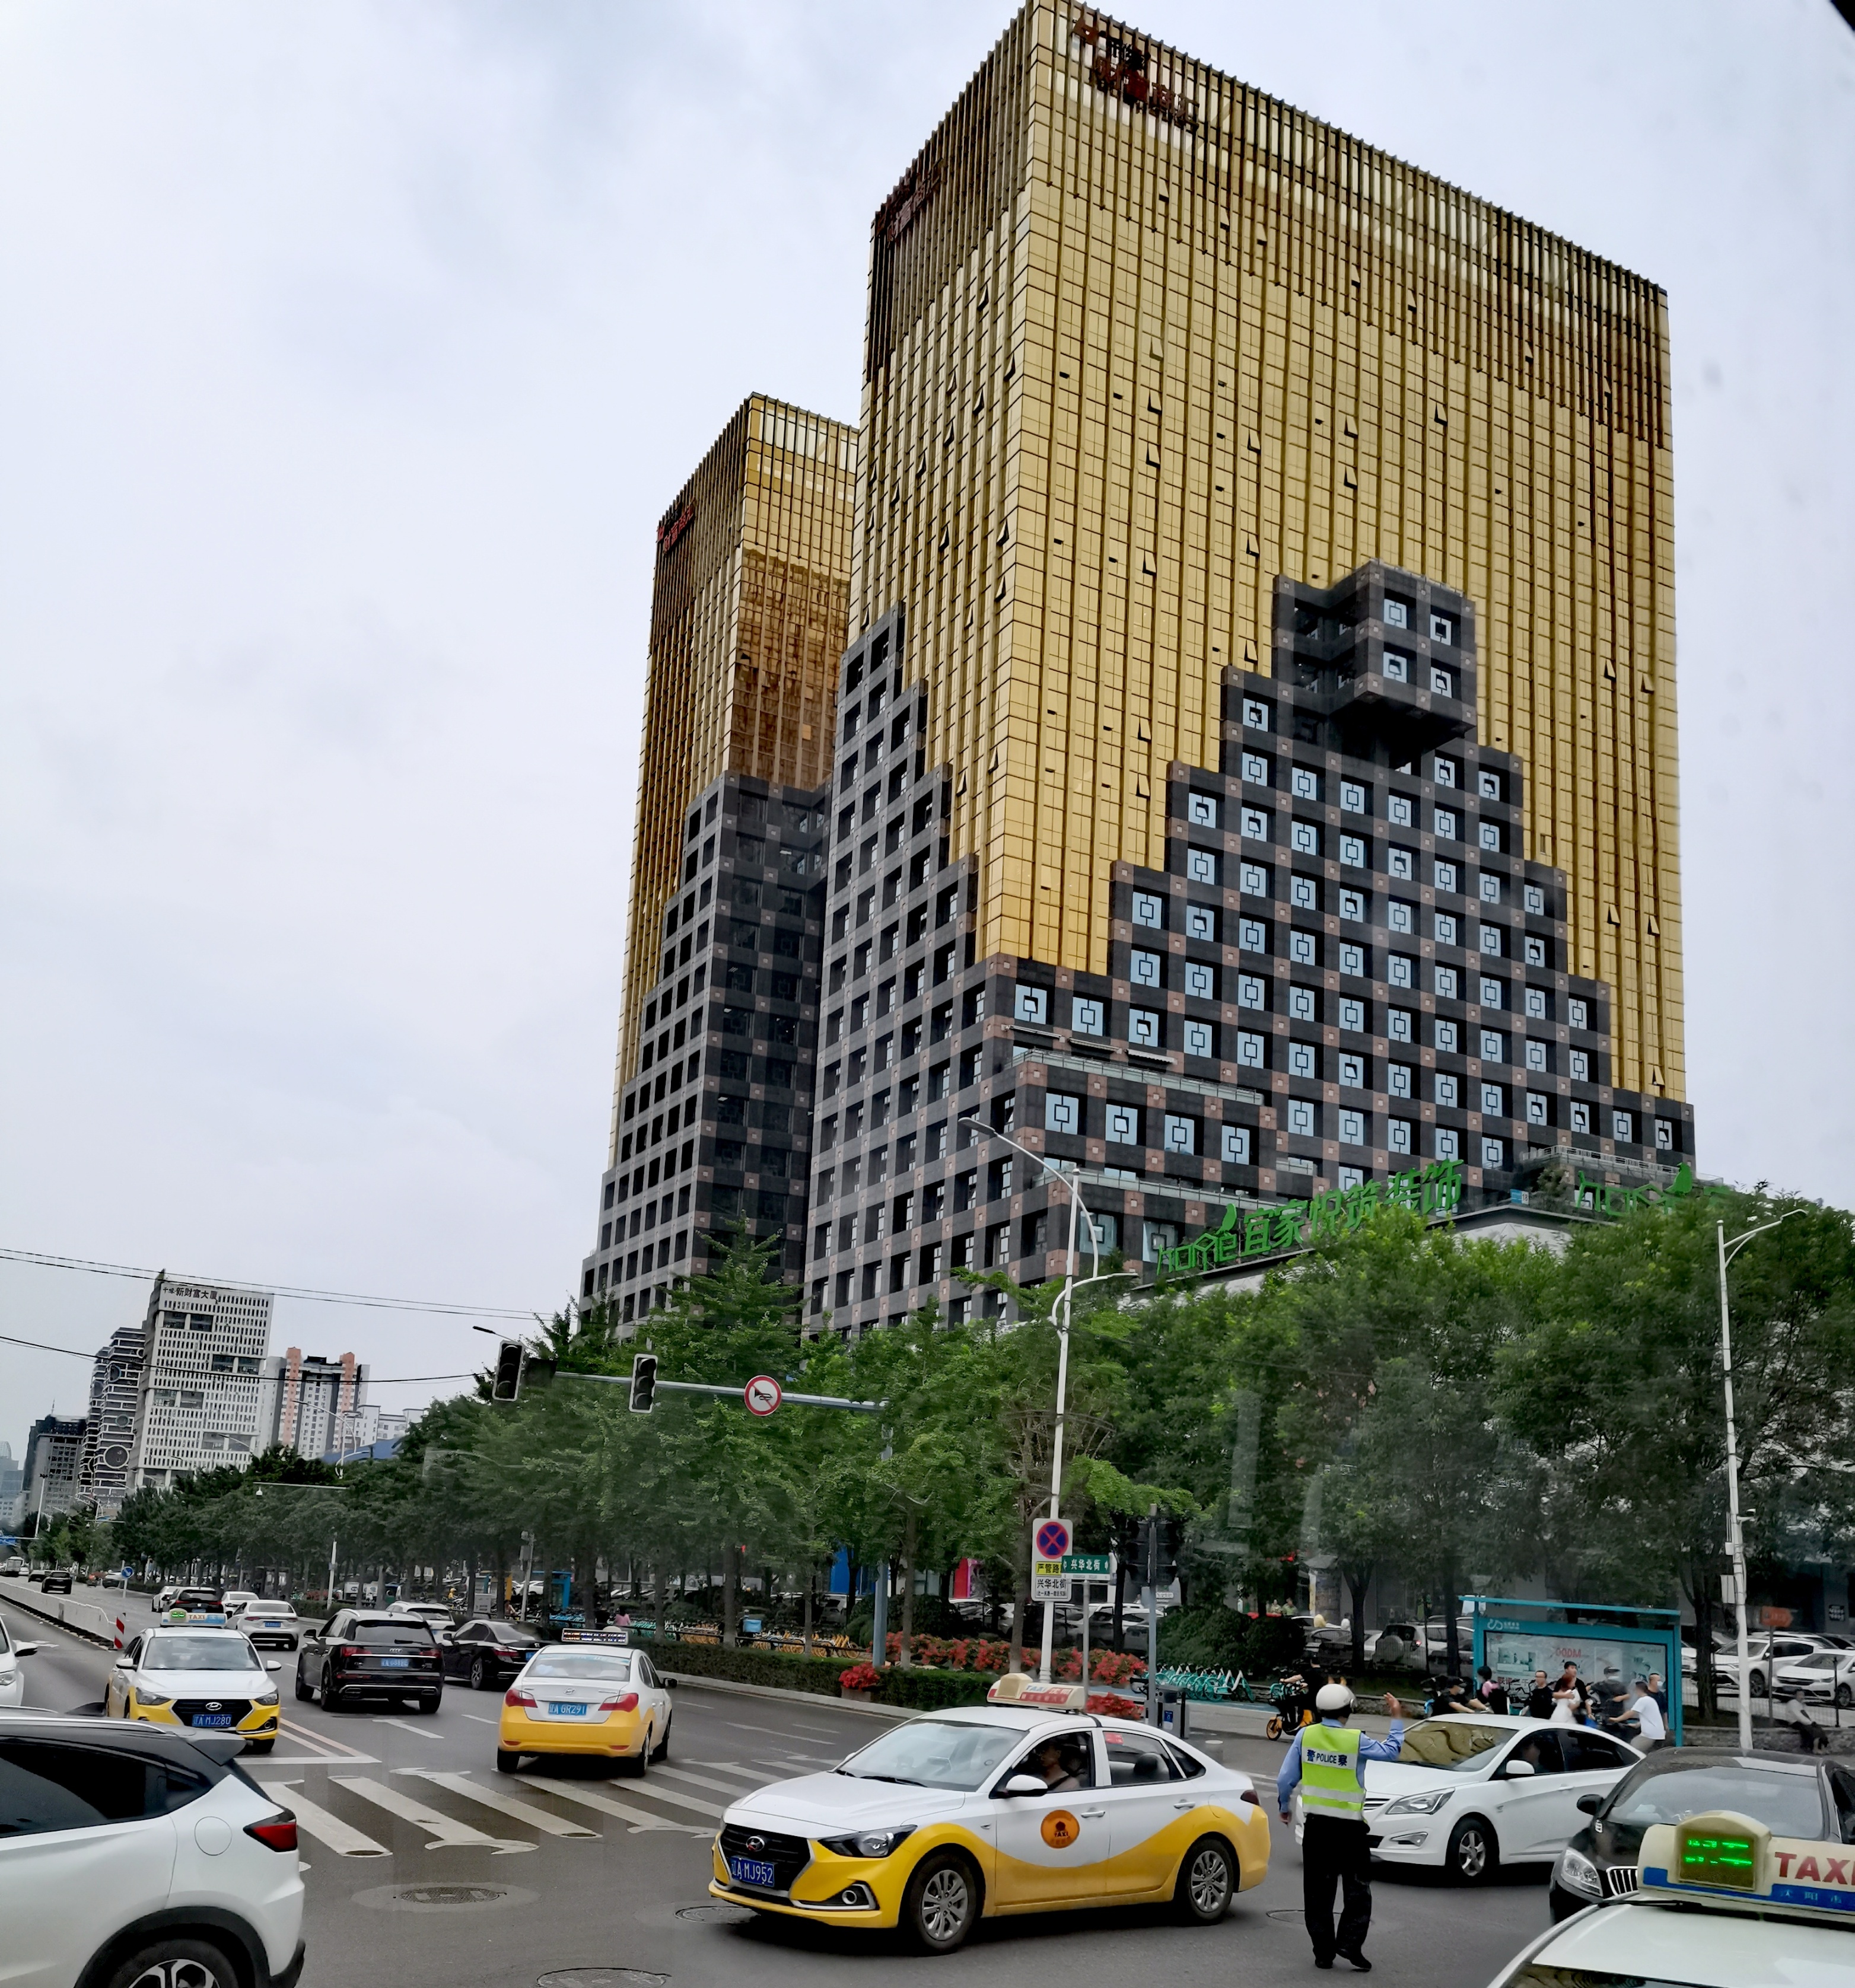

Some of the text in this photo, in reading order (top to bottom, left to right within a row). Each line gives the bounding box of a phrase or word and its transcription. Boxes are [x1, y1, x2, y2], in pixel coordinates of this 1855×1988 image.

[1037, 1563, 1061, 1573] 严管路
[1071, 1559, 1100, 1570] 兴华北街
[1037, 1579, 1066, 1589] 兴华北街
[1307, 1749, 1347, 1766] 警 POLICE 察
